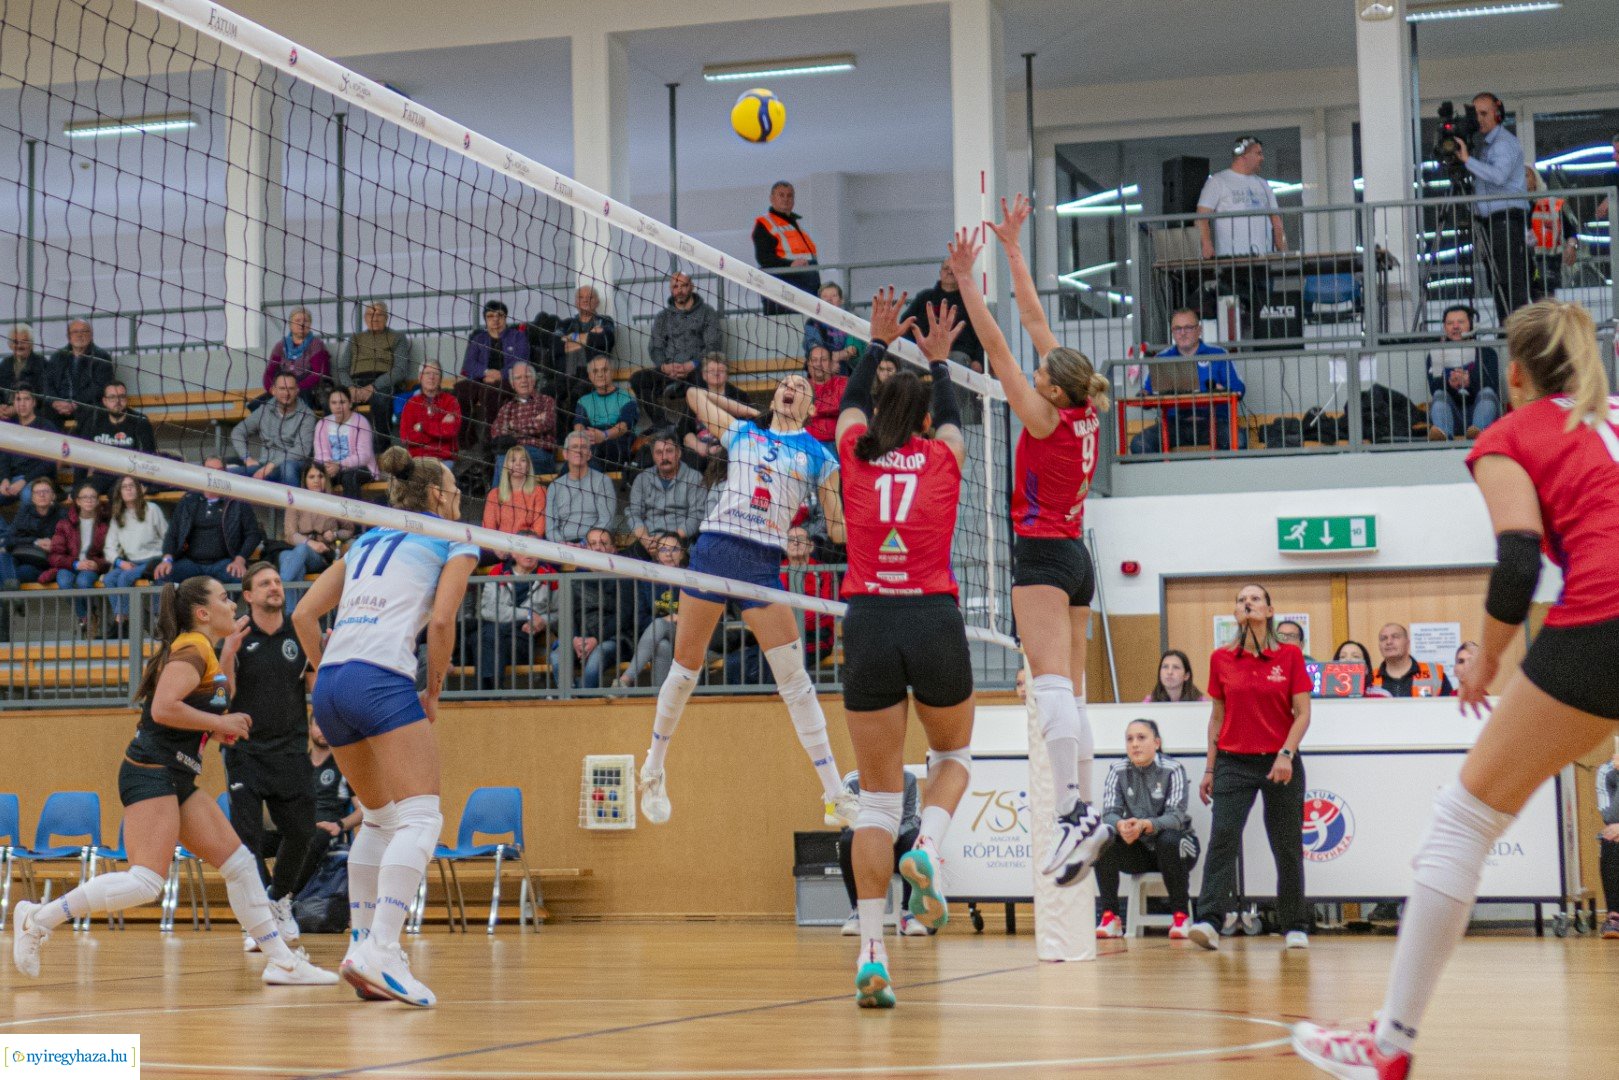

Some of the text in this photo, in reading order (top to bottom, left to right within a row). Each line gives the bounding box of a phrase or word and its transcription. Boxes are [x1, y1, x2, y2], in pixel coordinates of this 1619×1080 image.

[1260, 305, 1295, 318] ALTO
[1082, 433, 1095, 473] 9
[874, 473, 918, 523] 17
[352, 532, 408, 580] 11
[1334, 673, 1352, 696] 3
[1305, 791, 1336, 802] ATUM
